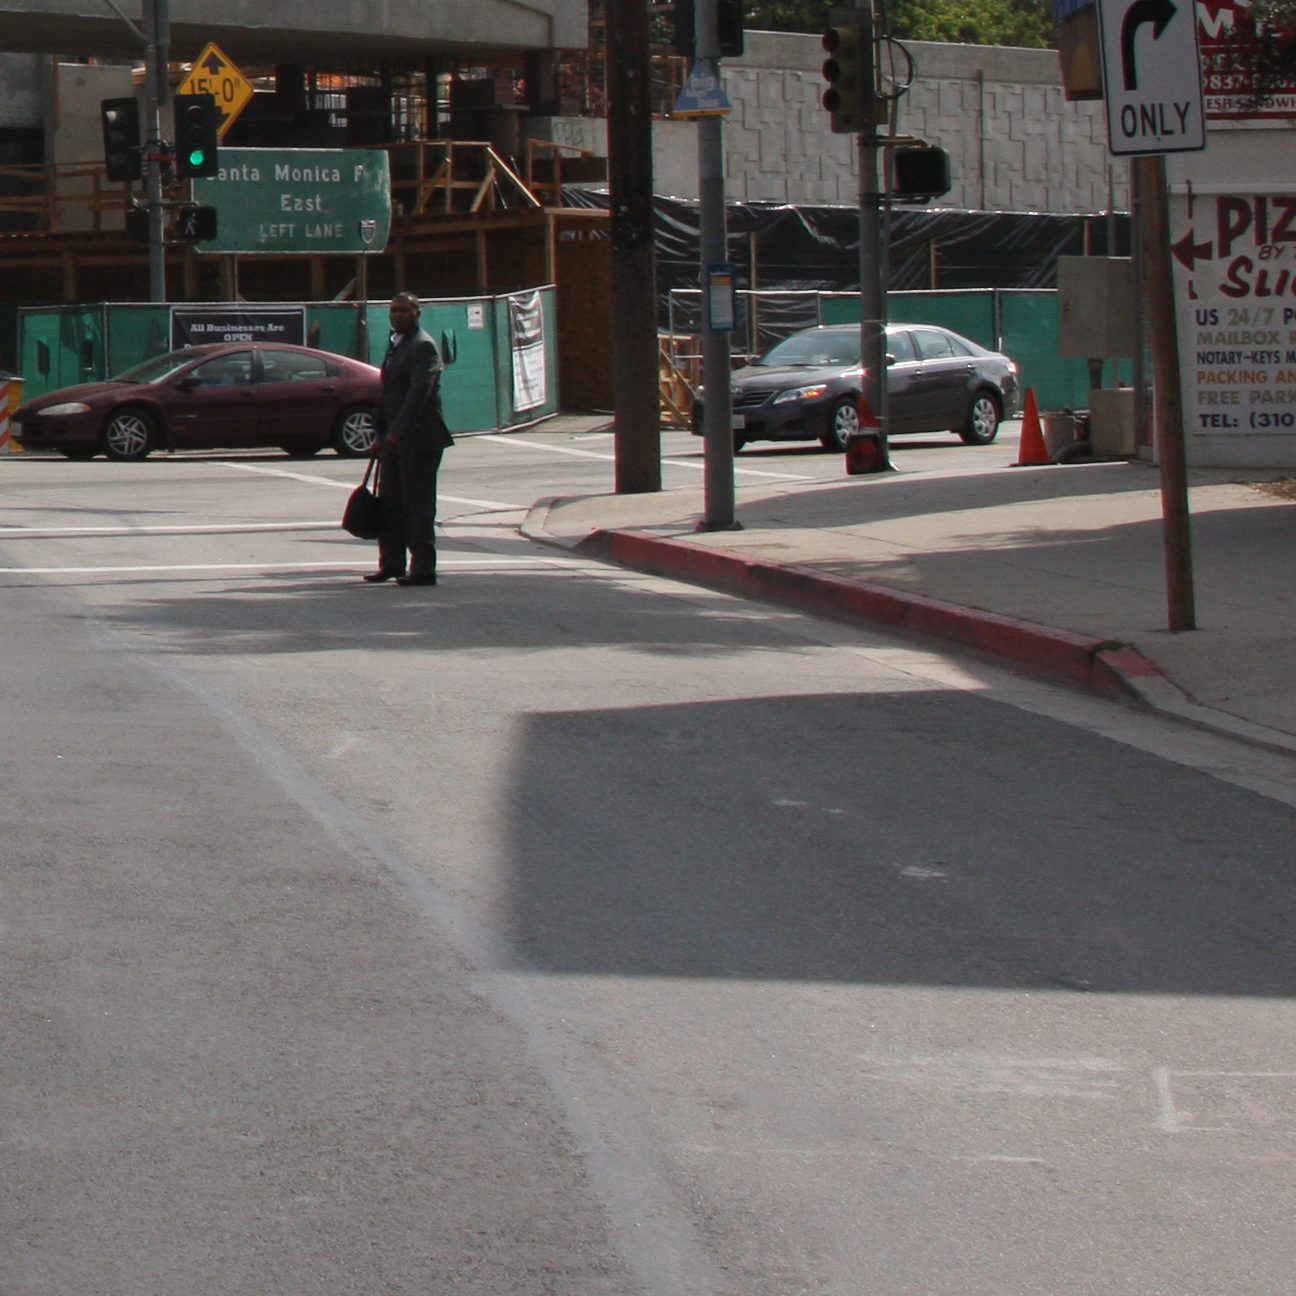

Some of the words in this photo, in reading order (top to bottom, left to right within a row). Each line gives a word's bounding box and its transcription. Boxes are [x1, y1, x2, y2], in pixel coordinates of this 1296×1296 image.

[1120, 102, 1191, 139] ONLY
[207, 164, 261, 182] anta
[274, 163, 341, 182] Monica
[280, 193, 323, 212] East
[259, 223, 296, 238] LEFT
[305, 223, 344, 238] LANE
[1258, 245, 1286, 261] BY
[1195, 308, 1219, 326] US
[1227, 307, 1275, 327] 24/7
[190, 323, 205, 332] All
[206, 323, 265, 332] Businesses
[267, 323, 285, 332] Are
[223, 333, 253, 342] OPEN
[1196, 330, 1281, 345] MAILBOX
[1196, 370, 1268, 384] PACKING
[1197, 390, 1240, 405] FREE
[1198, 413, 1239, 428] TEL:
